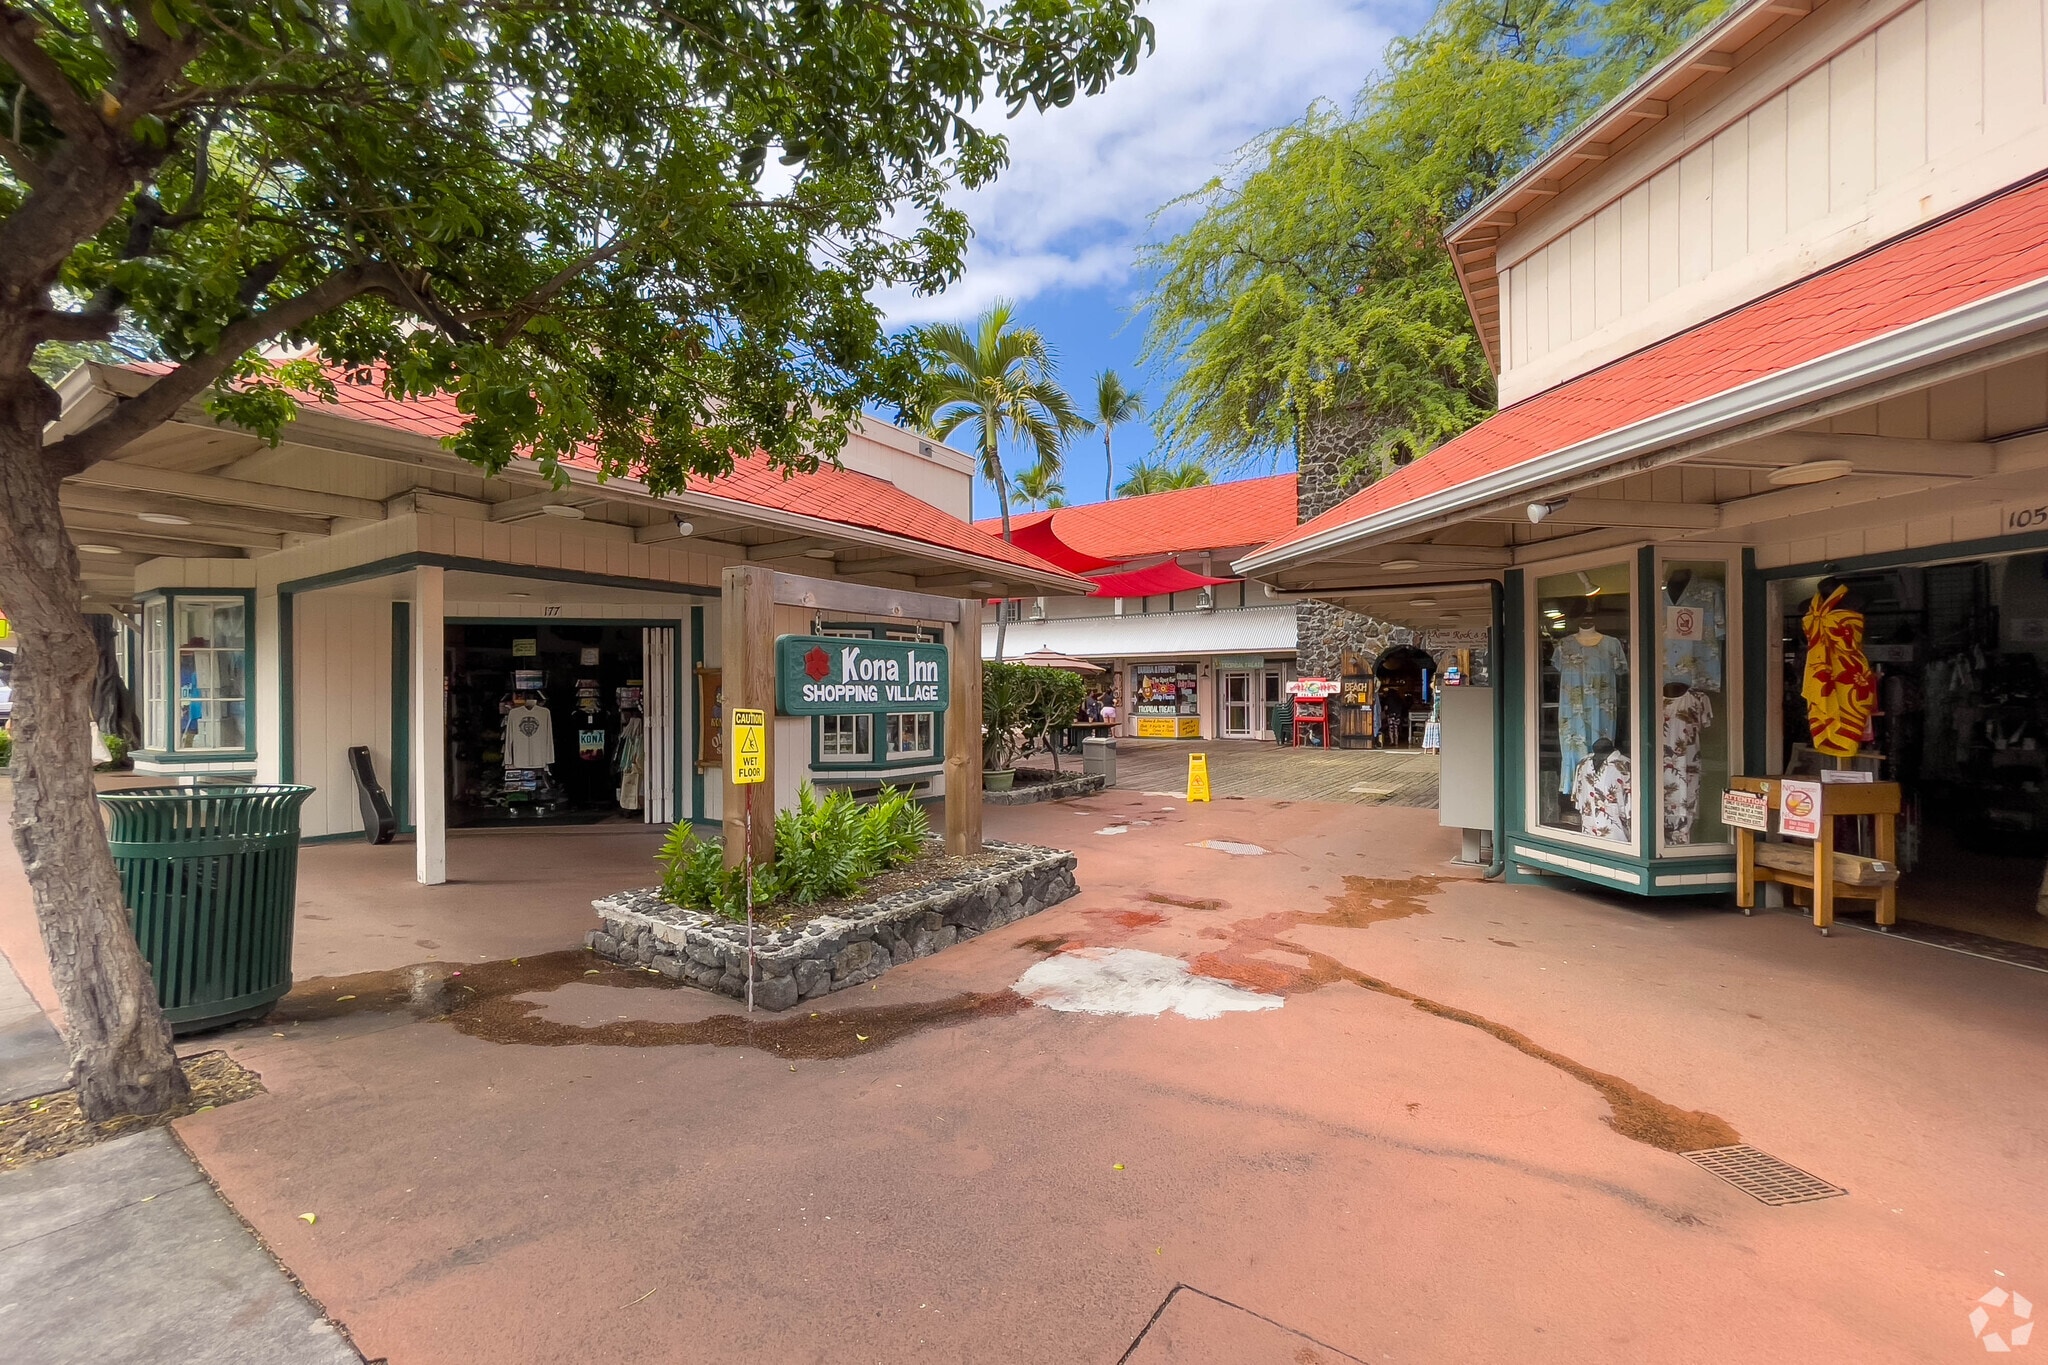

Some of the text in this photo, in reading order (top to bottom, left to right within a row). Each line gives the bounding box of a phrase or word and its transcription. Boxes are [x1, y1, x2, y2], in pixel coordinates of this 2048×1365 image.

[544, 606, 560, 617] 177
[841, 646, 939, 685] Kona Inn
[1345, 682, 1367, 692] BEACH
[802, 684, 939, 702] SHOPPING VILLAGE
[735, 712, 762, 724] CAUTION
[580, 734, 604, 744] KONA
[743, 757, 758, 766] WET
[739, 768, 760, 778] FLOOR
[1724, 794, 1767, 806] ATTENTION
